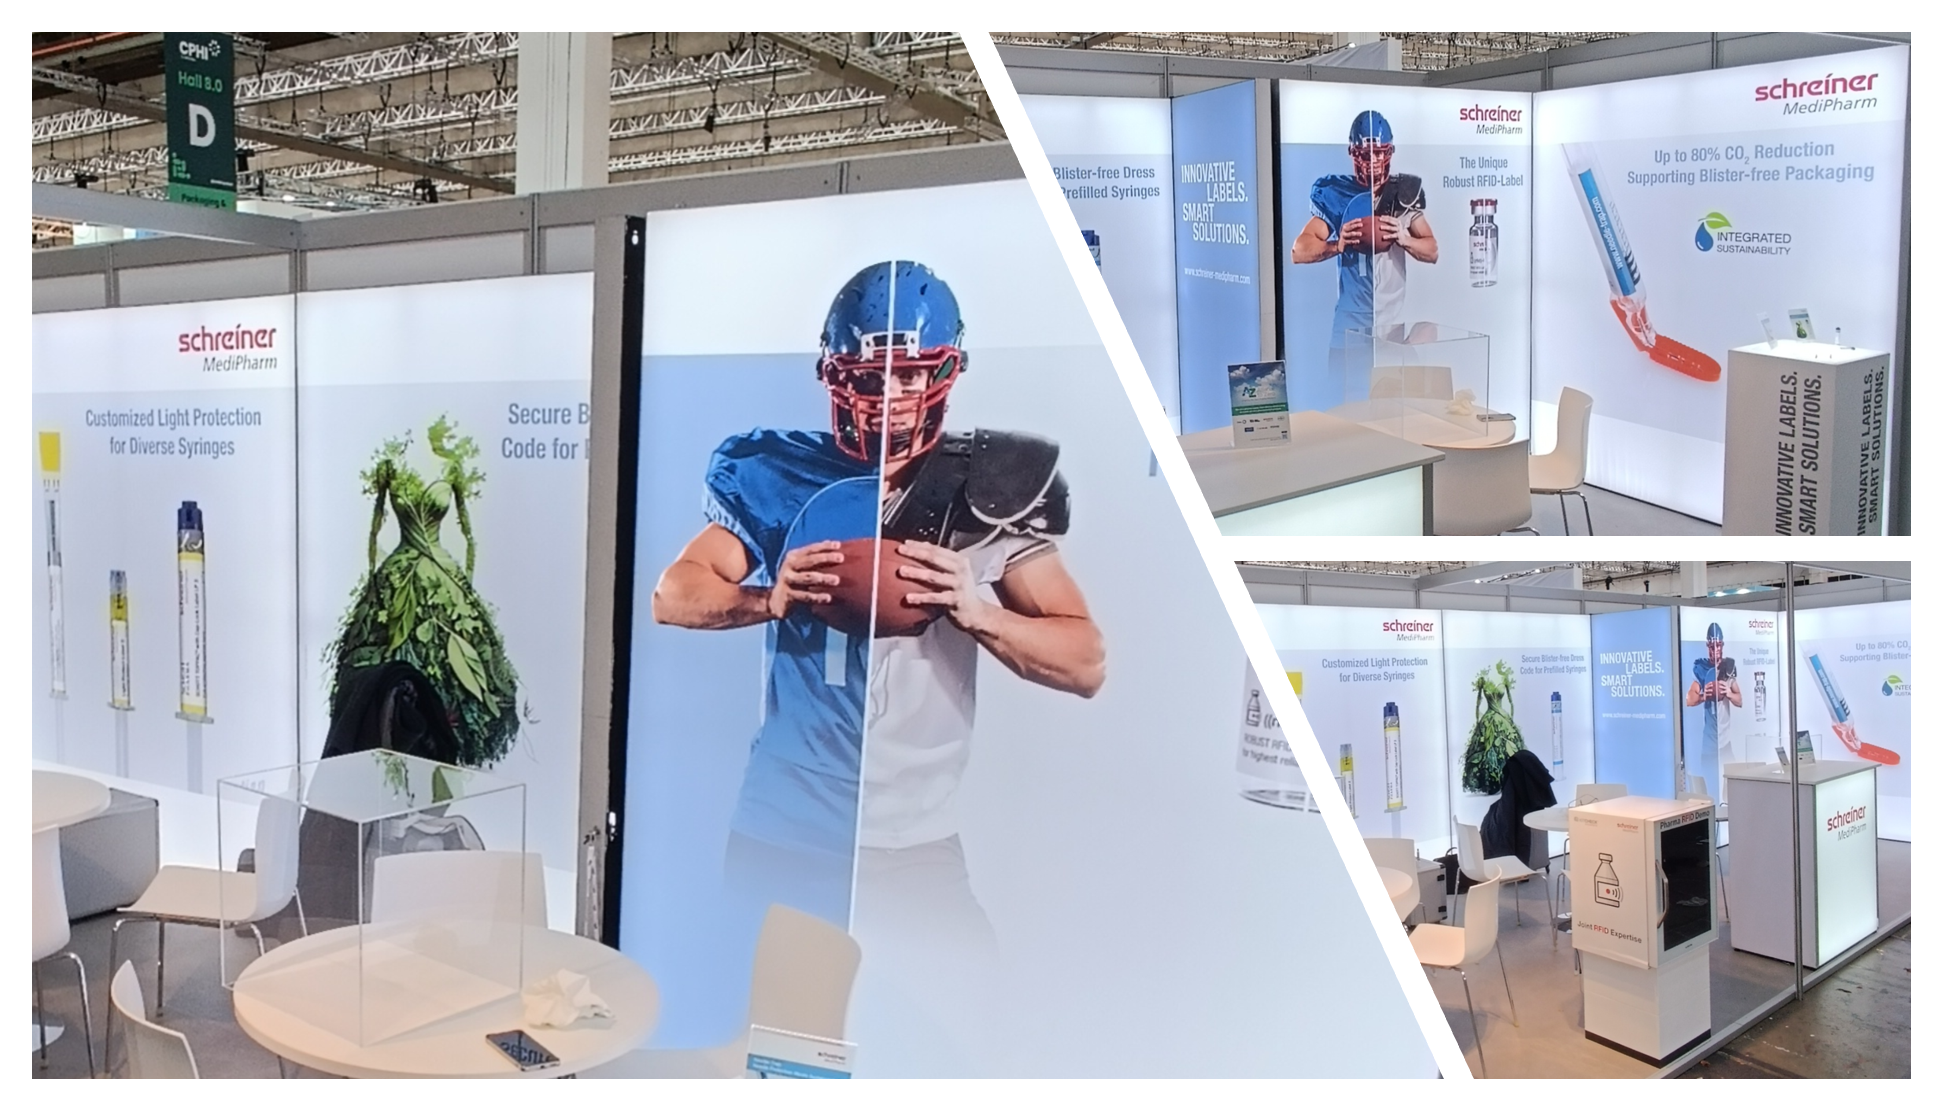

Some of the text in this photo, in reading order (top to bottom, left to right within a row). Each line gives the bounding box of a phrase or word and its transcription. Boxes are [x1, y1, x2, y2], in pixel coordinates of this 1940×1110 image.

[179, 41, 209, 60] CPHI
[178, 71, 223, 93] Hall 8.0
[1755, 73, 1879, 102] schreiner
[1460, 104, 1522, 122] schreiner
[1783, 97, 1878, 115] MediPharm
[189, 103, 216, 147] D
[1476, 124, 1523, 134] MediPharm
[1460, 156, 1508, 170] The Unique
[1654, 150, 1670, 166] Up
[1674, 149, 1687, 162] to
[1691, 146, 1720, 162] 80%
[1754, 142, 1834, 159] Reduction
[1053, 166, 1155, 180] Blister-free Dress
[1181, 161, 1236, 183] INNOVATIVE
[1443, 174, 1524, 188] Robust RFID-Label
[1628, 164, 1875, 186] Supporting Blister-free Packaging
[1111, 185, 1160, 200] Syringes
[1206, 182, 1248, 202] LABELS.
[1182, 202, 1214, 222] SMART
[1192, 222, 1250, 245] SOLUTIONS.
[1717, 232, 1792, 244] INTEGRATED
[1716, 244, 1791, 255] SUSTAINABILITY
[178, 324, 276, 352] schreiner
[202, 355, 278, 372] MediPharm
[86, 407, 262, 430] Customized Light Protection
[508, 403, 572, 424] Secure
[110, 436, 235, 459] for Diverse Syringes
[502, 437, 546, 459] Code
[552, 437, 578, 459] for
[1776, 371, 1798, 536] INNOVATIVE LABELS.
[1857, 369, 1874, 536] INNOVATIVE LABELS.
[1868, 366, 1884, 524] SMART SOLUTIONS.
[1799, 374, 1822, 535] SMART SOLUTIONS.
[1382, 619, 1434, 632] schreiner
[1748, 618, 1774, 628] schreiner
[1396, 634, 1434, 642] MediPharm
[1856, 642, 1866, 652] Up
[1868, 642, 1876, 650] to
[1322, 657, 1428, 670] Customized Light Protection
[1522, 654, 1584, 663] Secure Blister-free Dress
[1600, 650, 1652, 664] INNOVATIVE
[1840, 654, 1881, 663] Supporting
[1339, 671, 1415, 682] for Diverse Syringes
[1520, 665, 1587, 674] Code for Prefilled Syringes
[1626, 661, 1664, 674] LABELS.
[1601, 674, 1633, 686] SMART
[1611, 685, 1666, 698] SOLUTIONS.
[1660, 810, 1710, 830] Pharma RFID Demo
[1827, 806, 1866, 832] schreiner
[1577, 920, 1642, 944] Joint RFID Expertise
